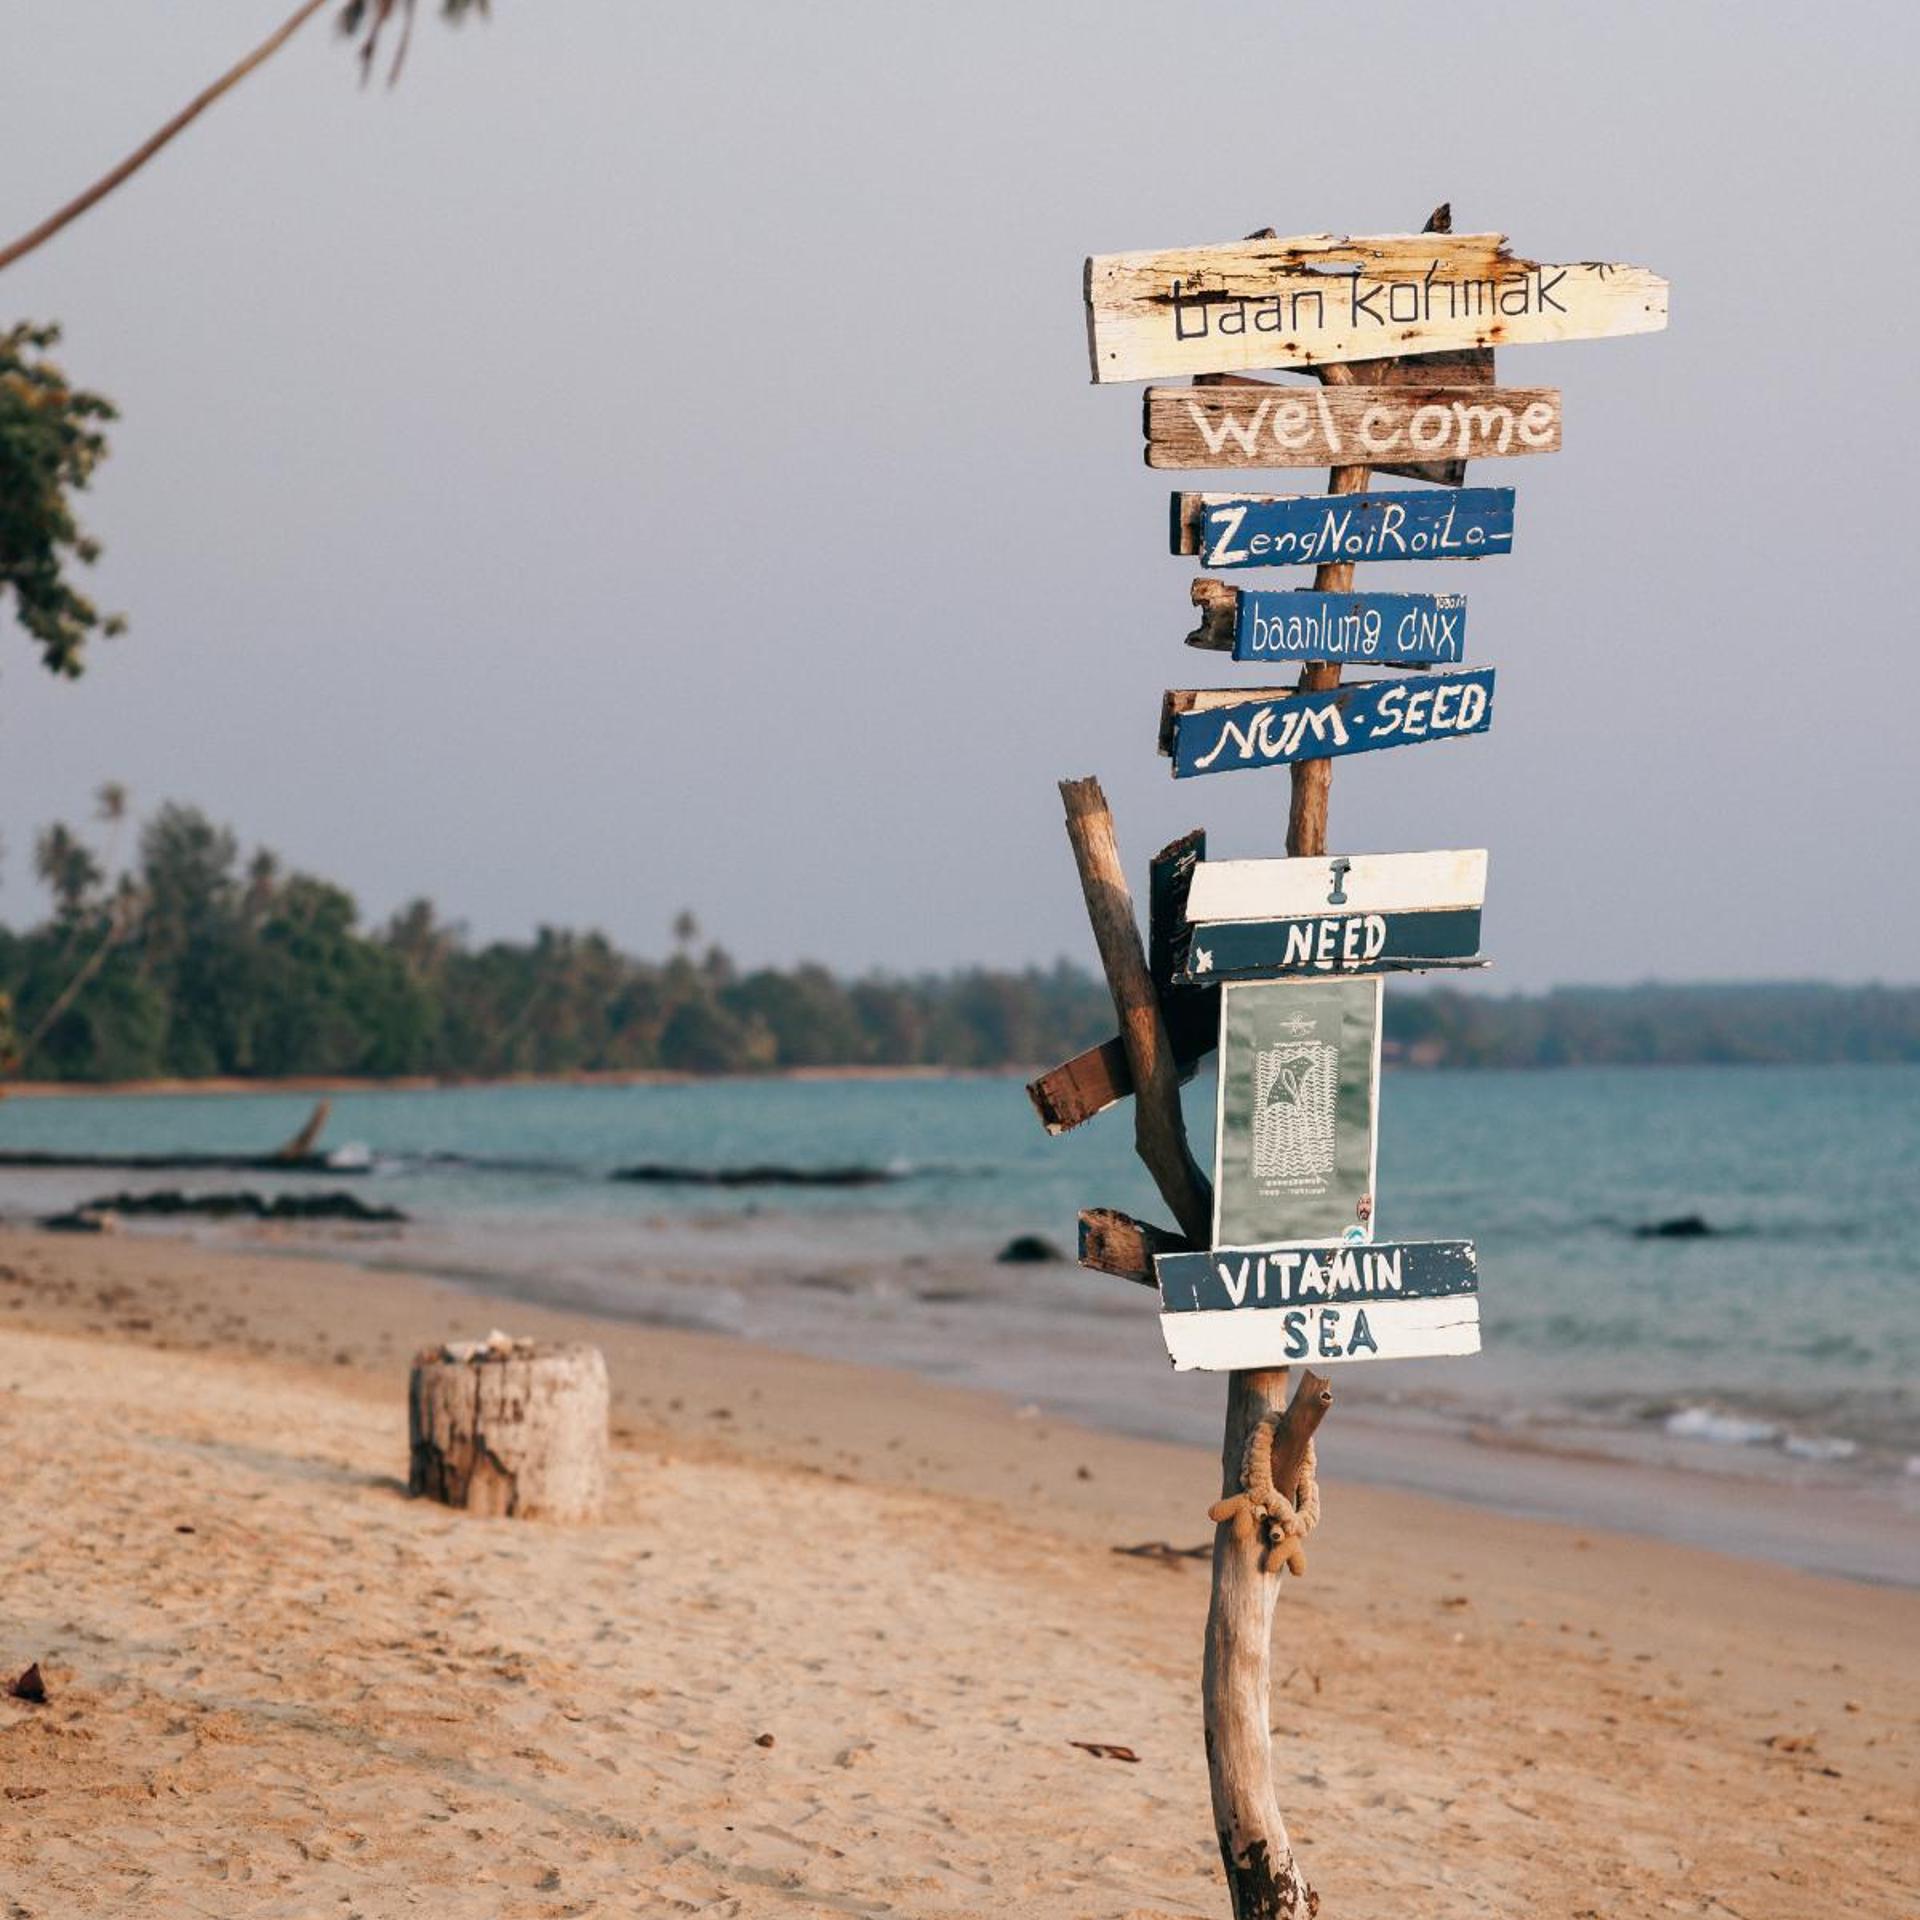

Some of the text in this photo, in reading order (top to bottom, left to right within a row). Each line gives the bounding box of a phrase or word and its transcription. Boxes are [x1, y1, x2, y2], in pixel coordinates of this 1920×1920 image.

[1174, 279, 1323, 340] baan
[1252, 601, 1459, 658] baanlung CNX
[1327, 857, 1350, 905] I
[1283, 914, 1387, 970] NEED
[1217, 1249, 1402, 1306] VITAMIN
[1281, 1308, 1379, 1359] SEA
